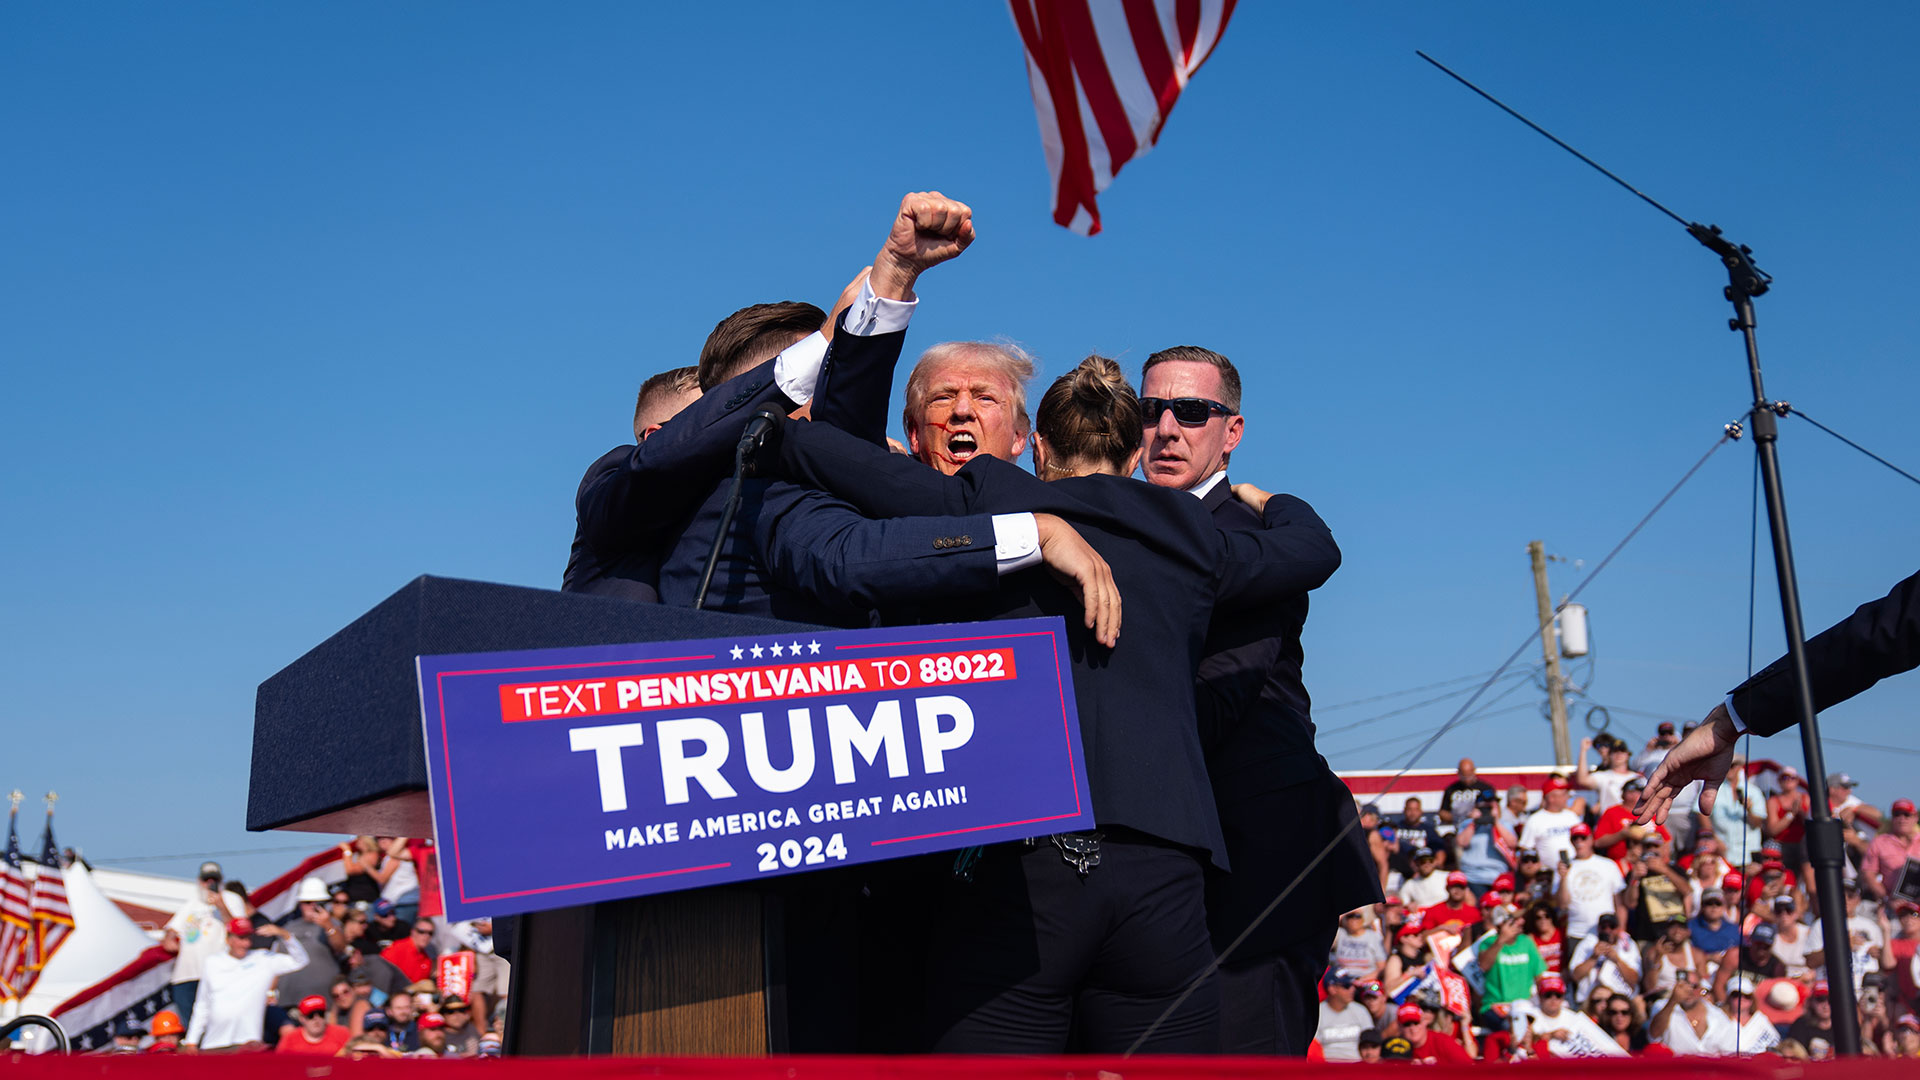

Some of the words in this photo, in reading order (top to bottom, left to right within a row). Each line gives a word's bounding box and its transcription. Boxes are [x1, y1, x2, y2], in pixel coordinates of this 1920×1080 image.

[515, 682, 606, 717] TEXT
[617, 661, 866, 709] PENNSYLVANIA
[870, 659, 911, 686] TO
[919, 652, 1005, 684] 88022
[568, 695, 975, 813] TRUMP
[604, 822, 680, 851] MAKE
[688, 806, 801, 843] AMERICA
[808, 796, 883, 826] GREAT
[891, 785, 968, 813] AGAIN!
[756, 832, 848, 872] 2024
